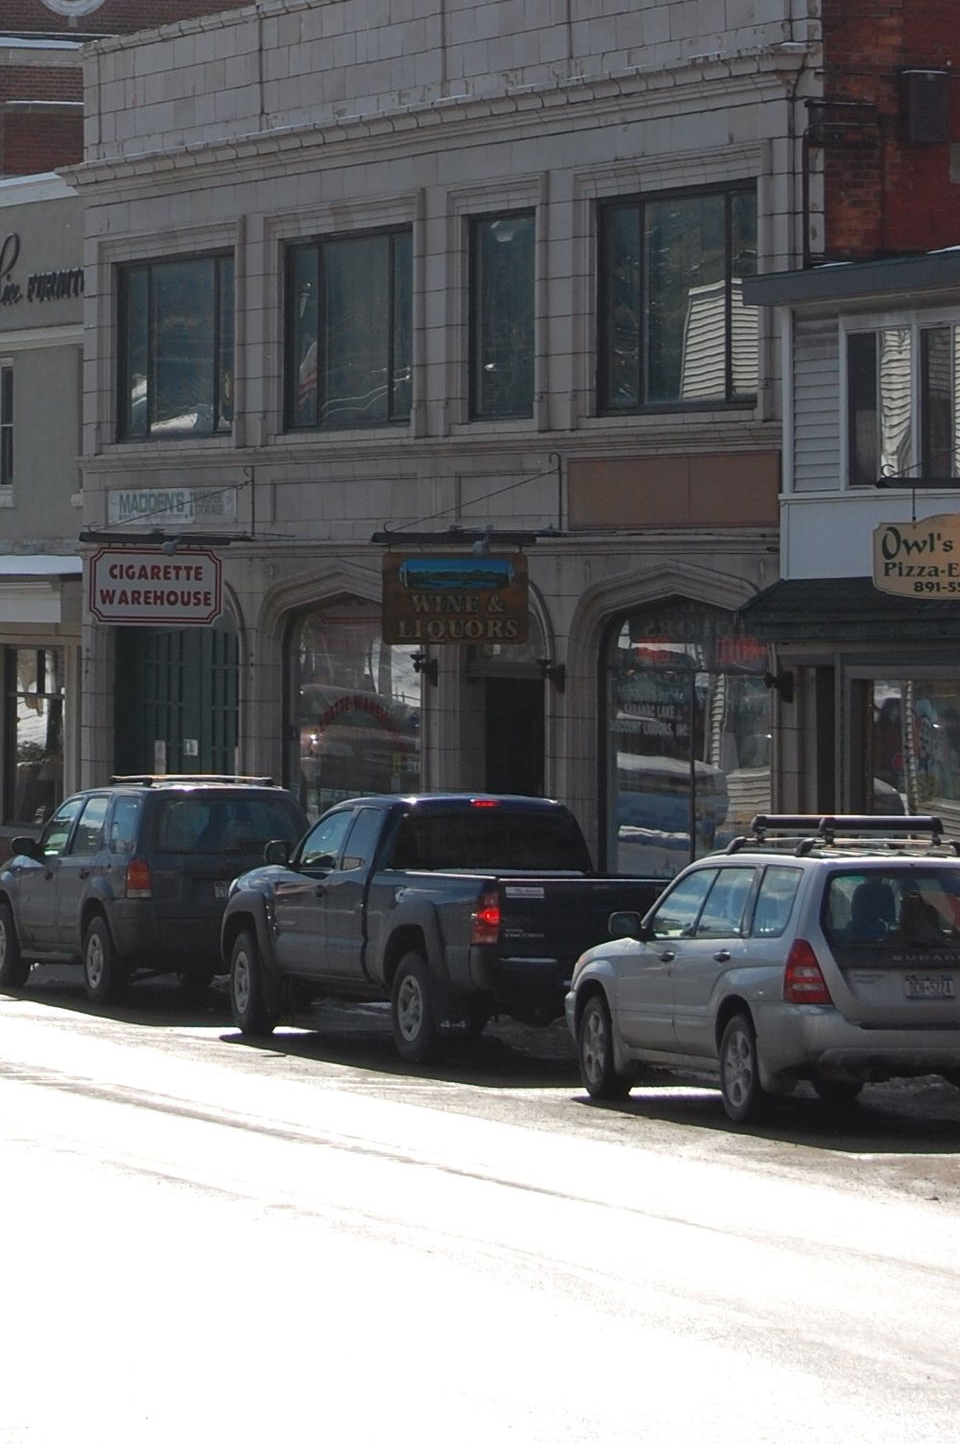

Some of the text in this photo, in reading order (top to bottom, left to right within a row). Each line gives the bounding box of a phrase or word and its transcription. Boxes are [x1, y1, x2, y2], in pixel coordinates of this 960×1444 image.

[882, 526, 954, 560] Owl's
[108, 564, 203, 581] CIGARETTE
[913, 581, 960, 593] 891-5
[100, 589, 212, 606] WAREHOUSE
[410, 595, 505, 613] WINE &
[398, 619, 519, 643] LIQUORS
[892, 953, 960, 961] SUBAR
